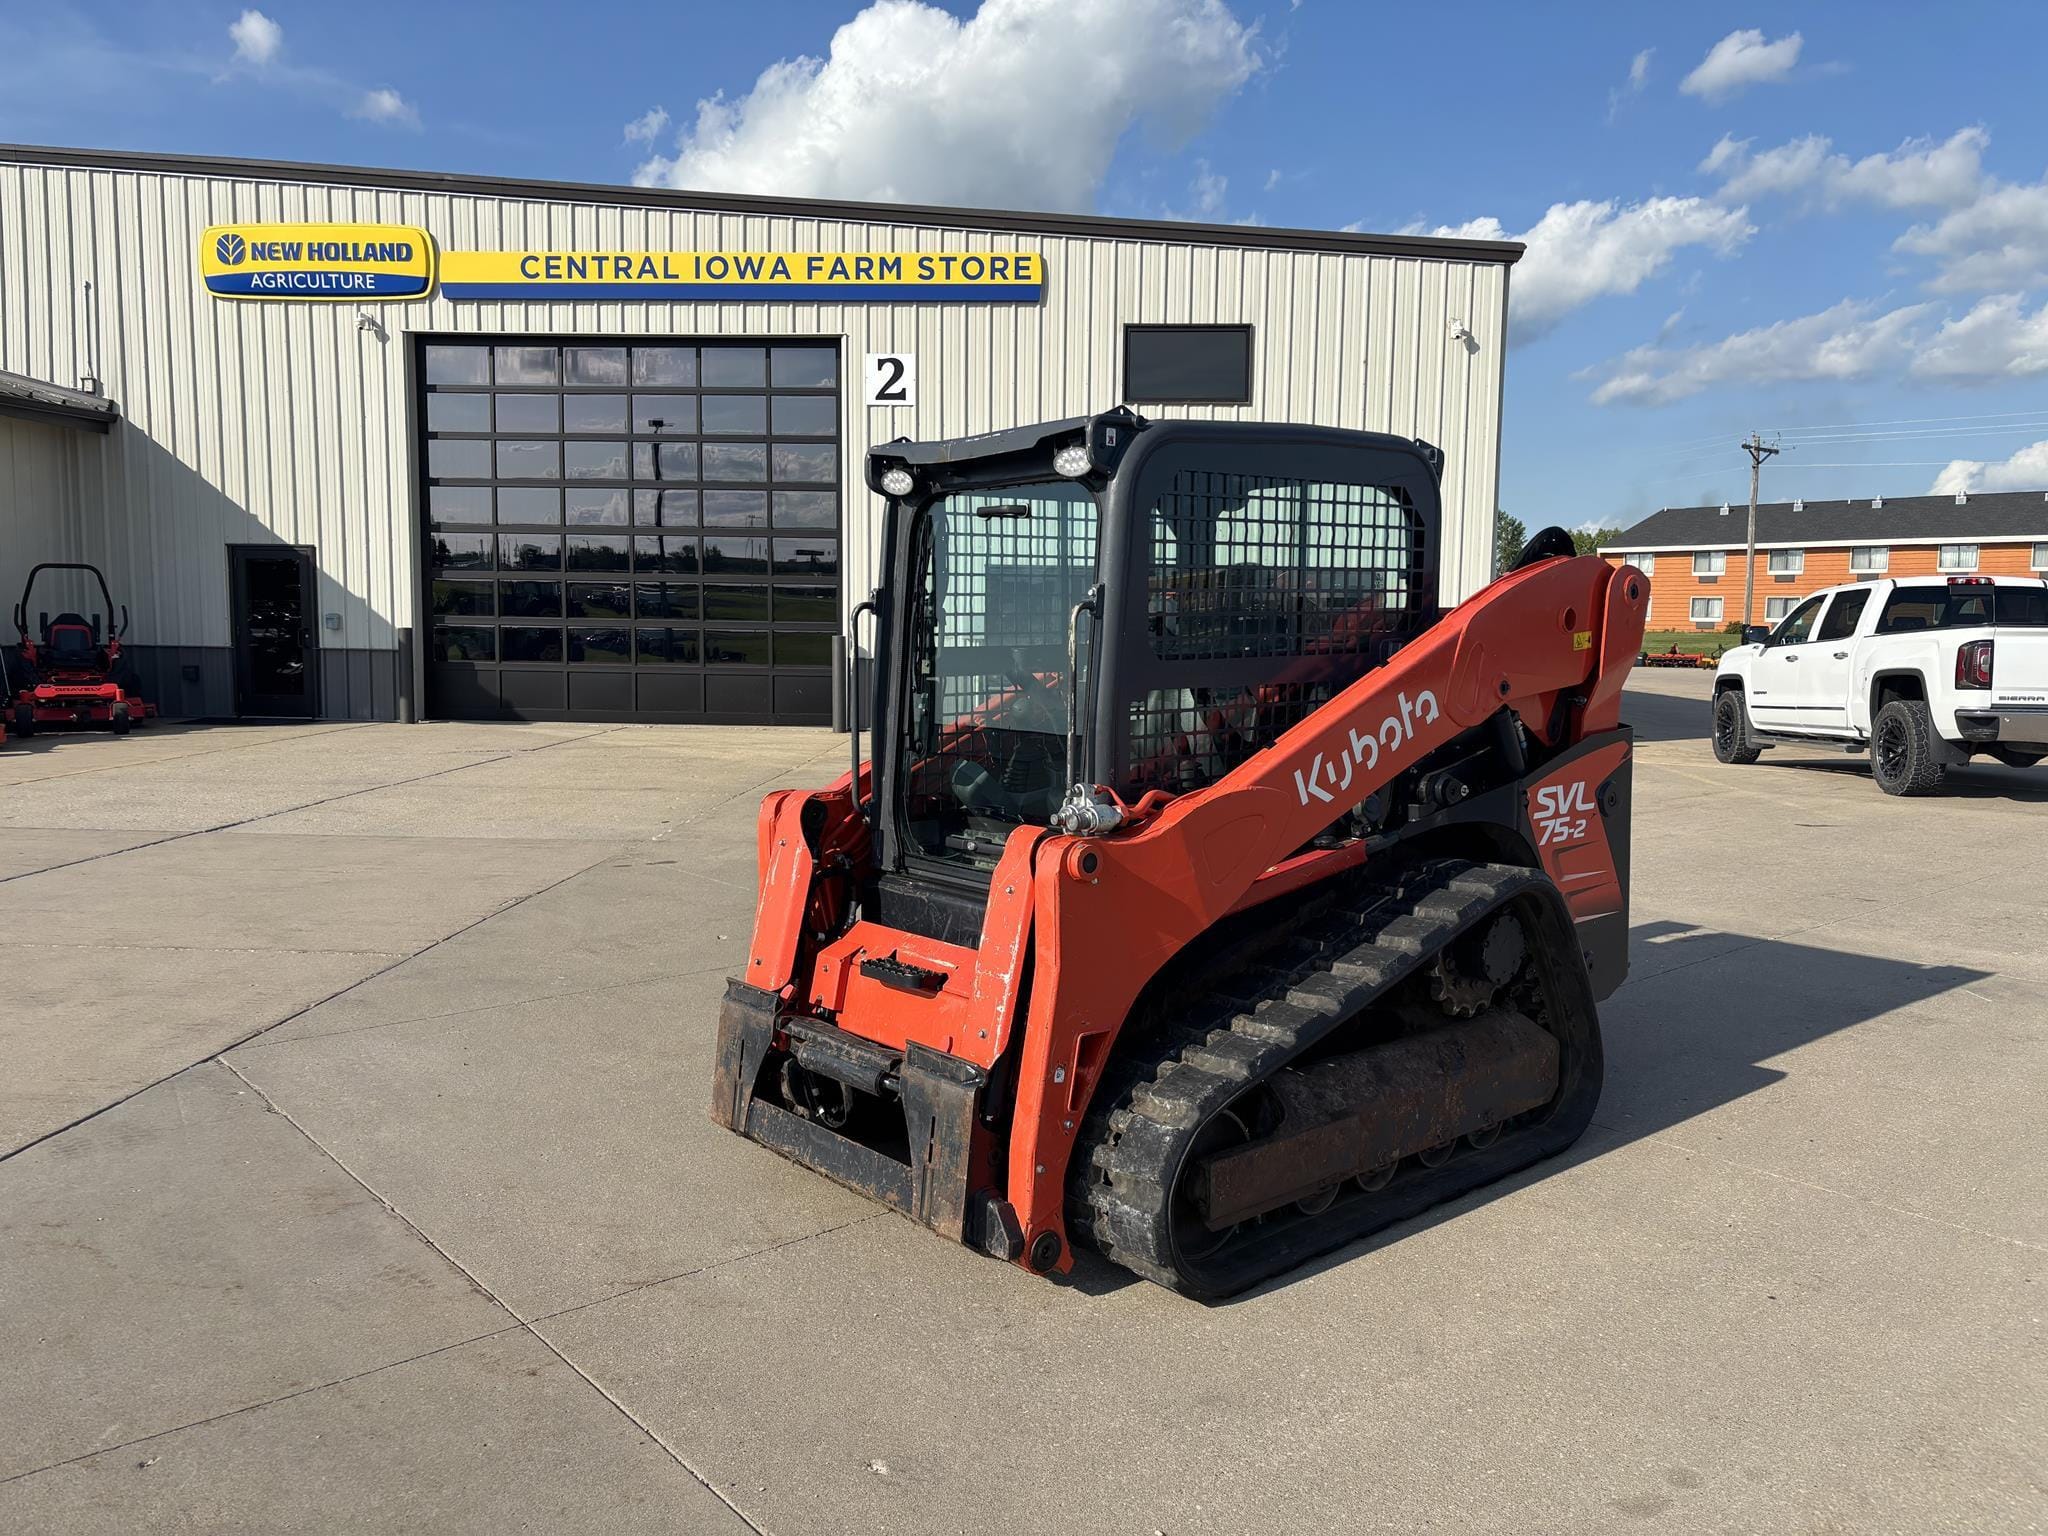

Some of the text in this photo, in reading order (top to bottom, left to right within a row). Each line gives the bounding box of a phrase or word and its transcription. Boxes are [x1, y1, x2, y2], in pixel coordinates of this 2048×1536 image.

[251, 241, 413, 262] NEW HOLLAND
[251, 273, 376, 289] AGRICULTURE
[520, 255, 1033, 280] CENTRAL IOWA FARM STORE
[876, 356, 907, 401] 2
[1293, 690, 1440, 806] Kubota
[1533, 781, 1595, 819] SVL
[1538, 817, 1587, 846] 75-2
